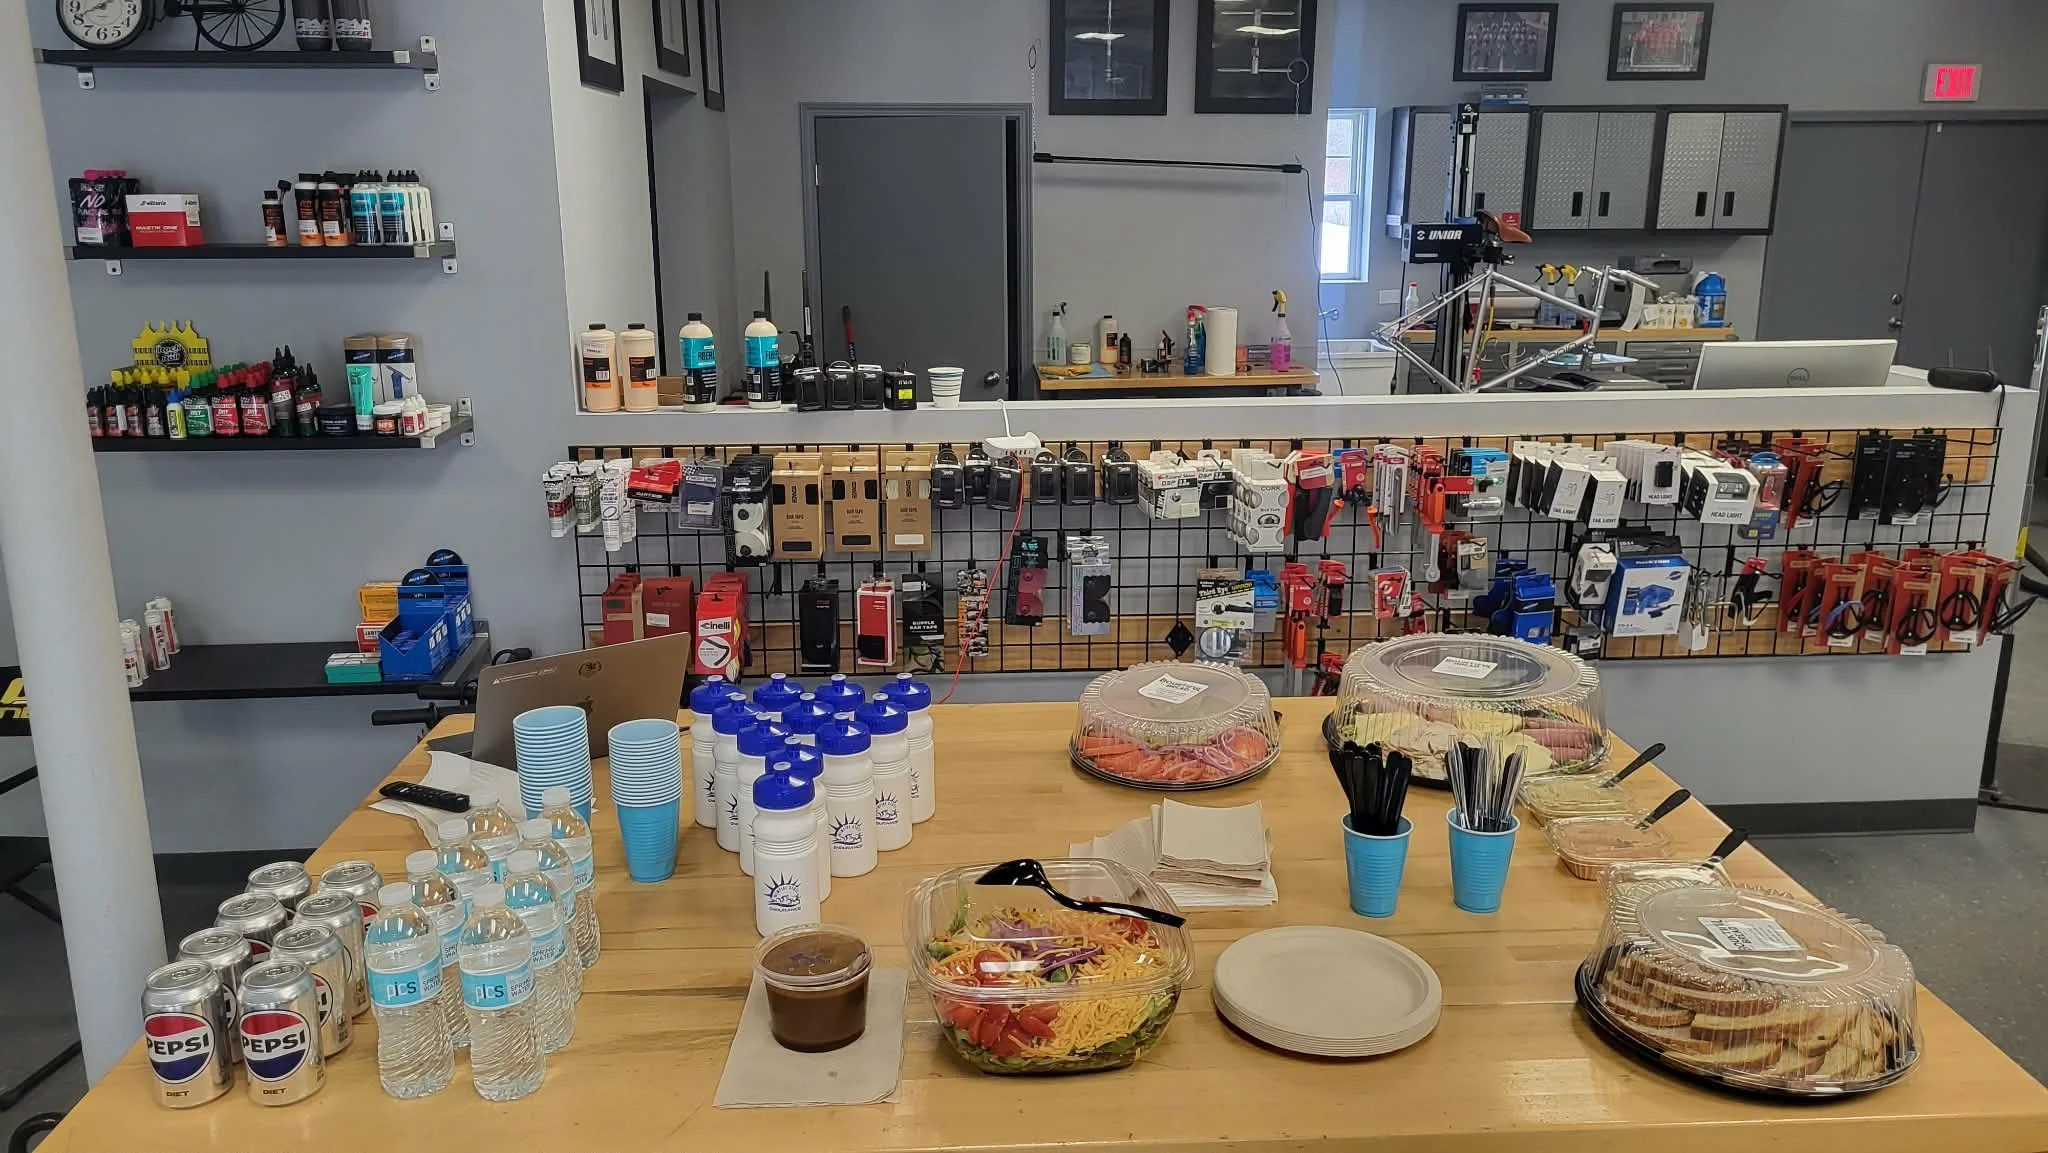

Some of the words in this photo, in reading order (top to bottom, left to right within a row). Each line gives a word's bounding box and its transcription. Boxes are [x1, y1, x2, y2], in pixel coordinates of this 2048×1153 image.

[127, 4, 137, 15] 3
[73, 14, 84, 25] 8
[121, 16, 130, 28] 4
[84, 24, 94, 36] 7
[96, 27, 107, 40] 6
[112, 25, 121, 37] 5
[1935, 67, 1976, 98] EXIT
[80, 194, 105, 208] NO
[1429, 230, 1463, 240] UNIOR
[1198, 588, 1217, 597] Third
[1217, 586, 1229, 594] Eye
[532, 946, 555, 957] SPRING
[533, 952, 555, 963] WATER
[387, 981, 417, 1001] pics
[475, 984, 505, 1003] pics
[147, 1033, 209, 1055] PEPSI
[243, 1032, 305, 1053] PEPSI
